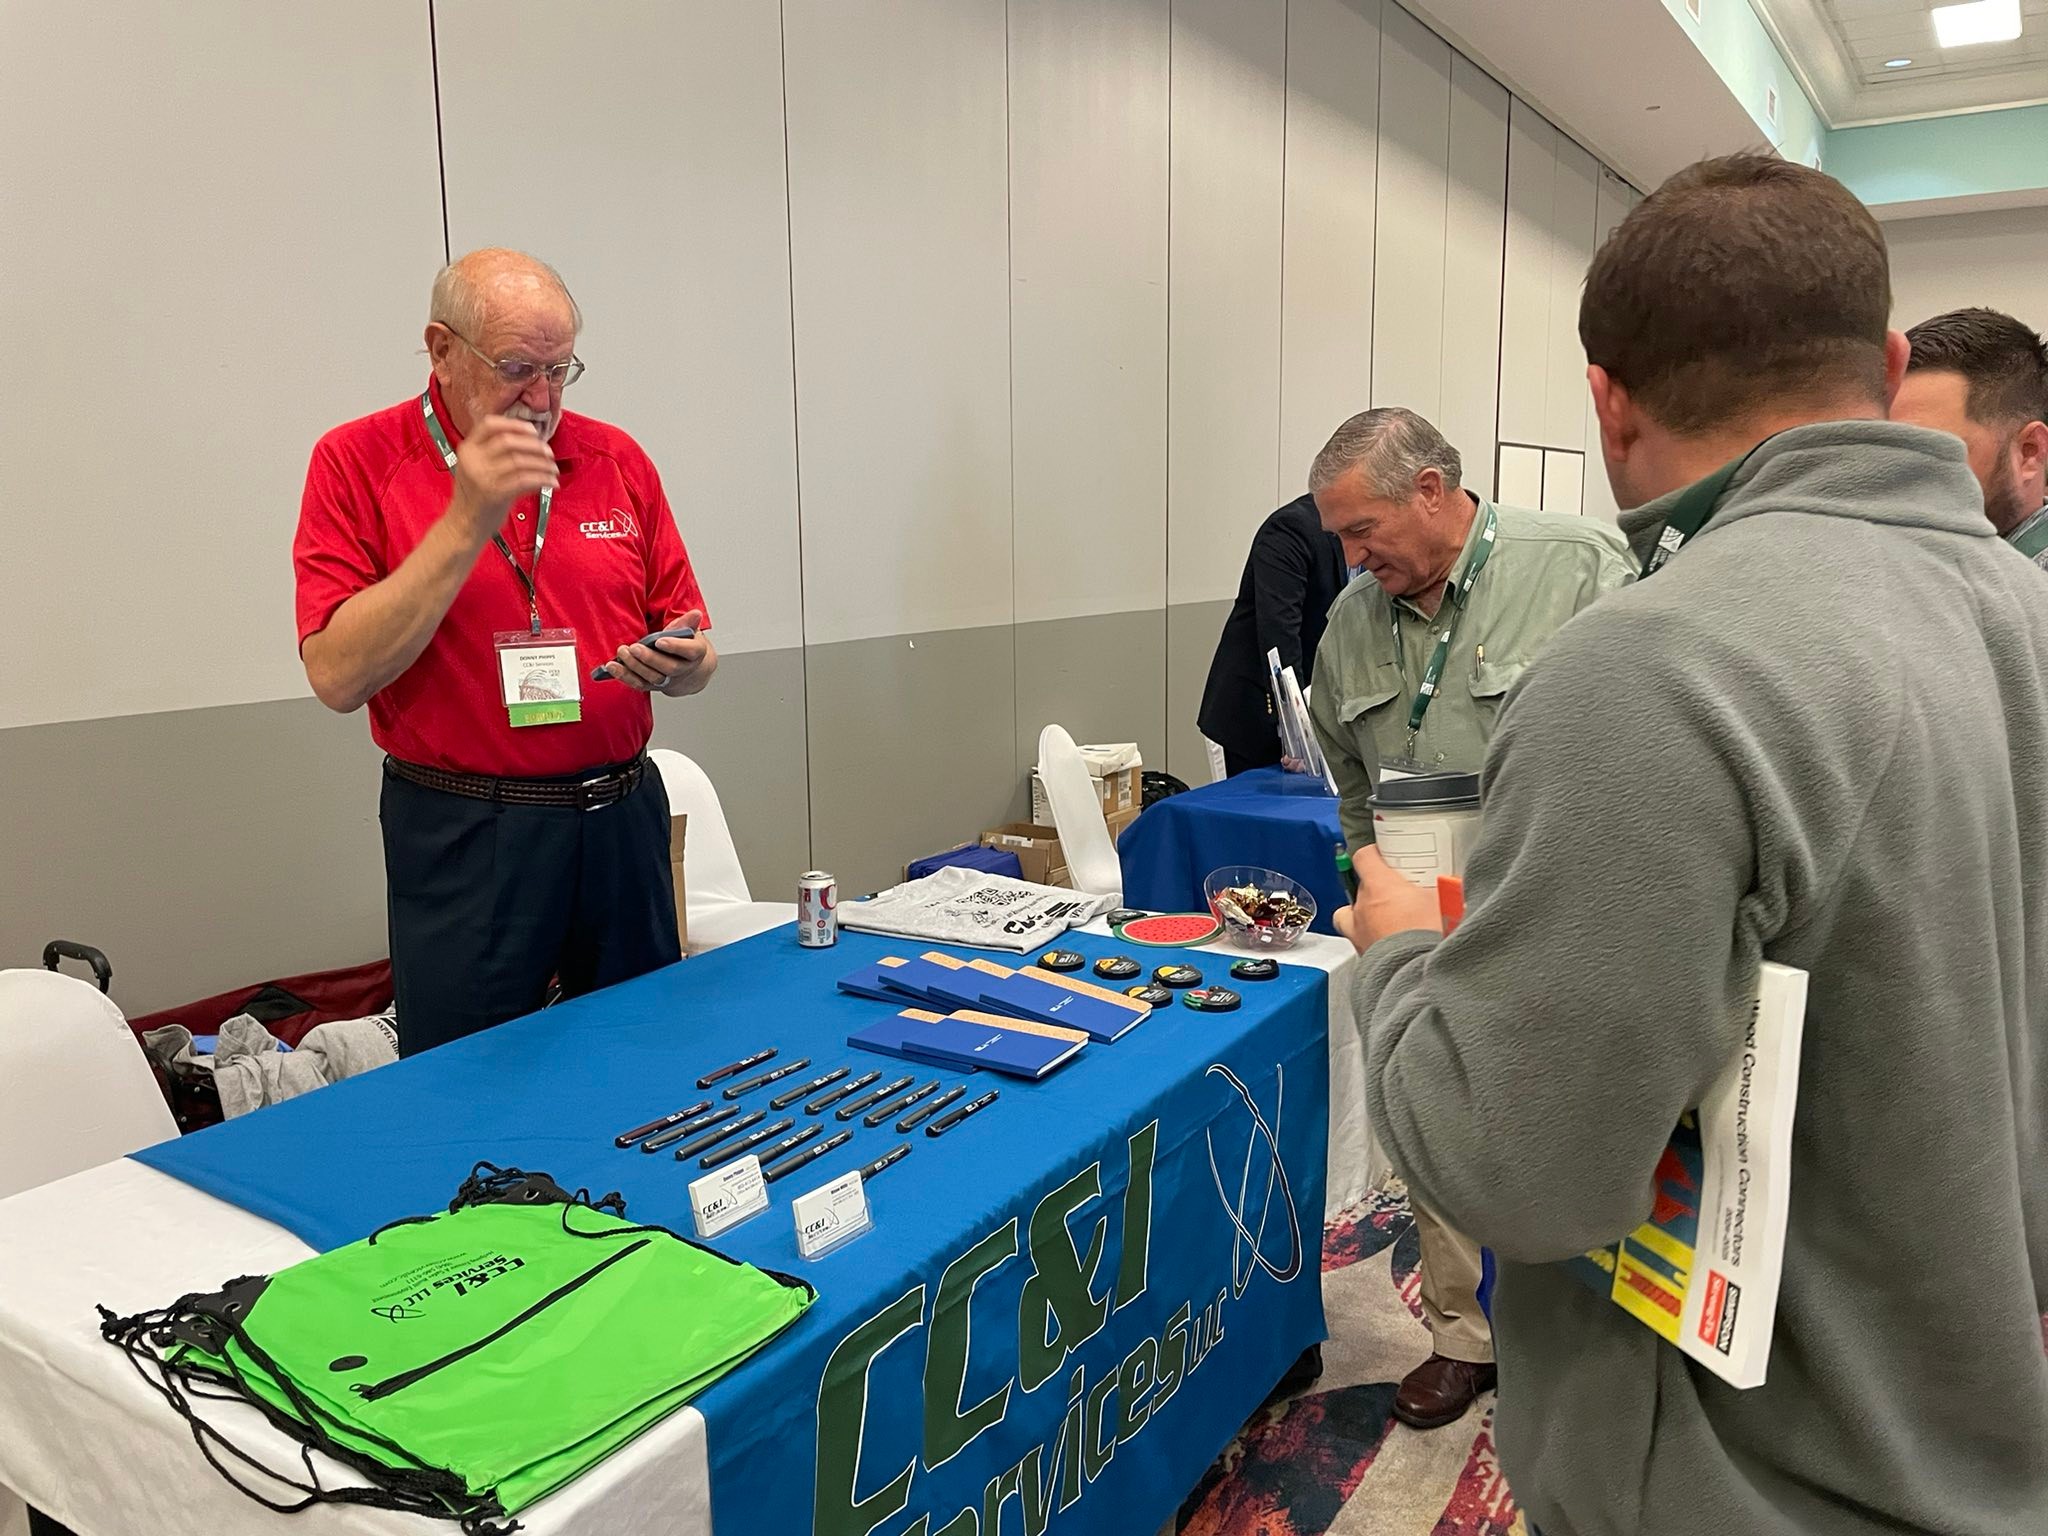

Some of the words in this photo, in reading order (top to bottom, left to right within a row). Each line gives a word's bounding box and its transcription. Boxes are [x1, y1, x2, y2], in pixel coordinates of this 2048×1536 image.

[580, 520, 614, 532] CC&I
[1737, 1053, 1756, 1164] Construction
[702, 1198, 722, 1215] CC&I
[1731, 1168, 1751, 1268] Connectors
[805, 1218, 825, 1234] CC&I
[432, 1254, 508, 1290] Services
[453, 1257, 525, 1296] CC&I
[403, 1287, 432, 1307] LLC
[813, 1119, 1159, 1536] CC&I
[862, 1300, 1191, 1536] rvices
[1188, 1287, 1228, 1376] LLC
